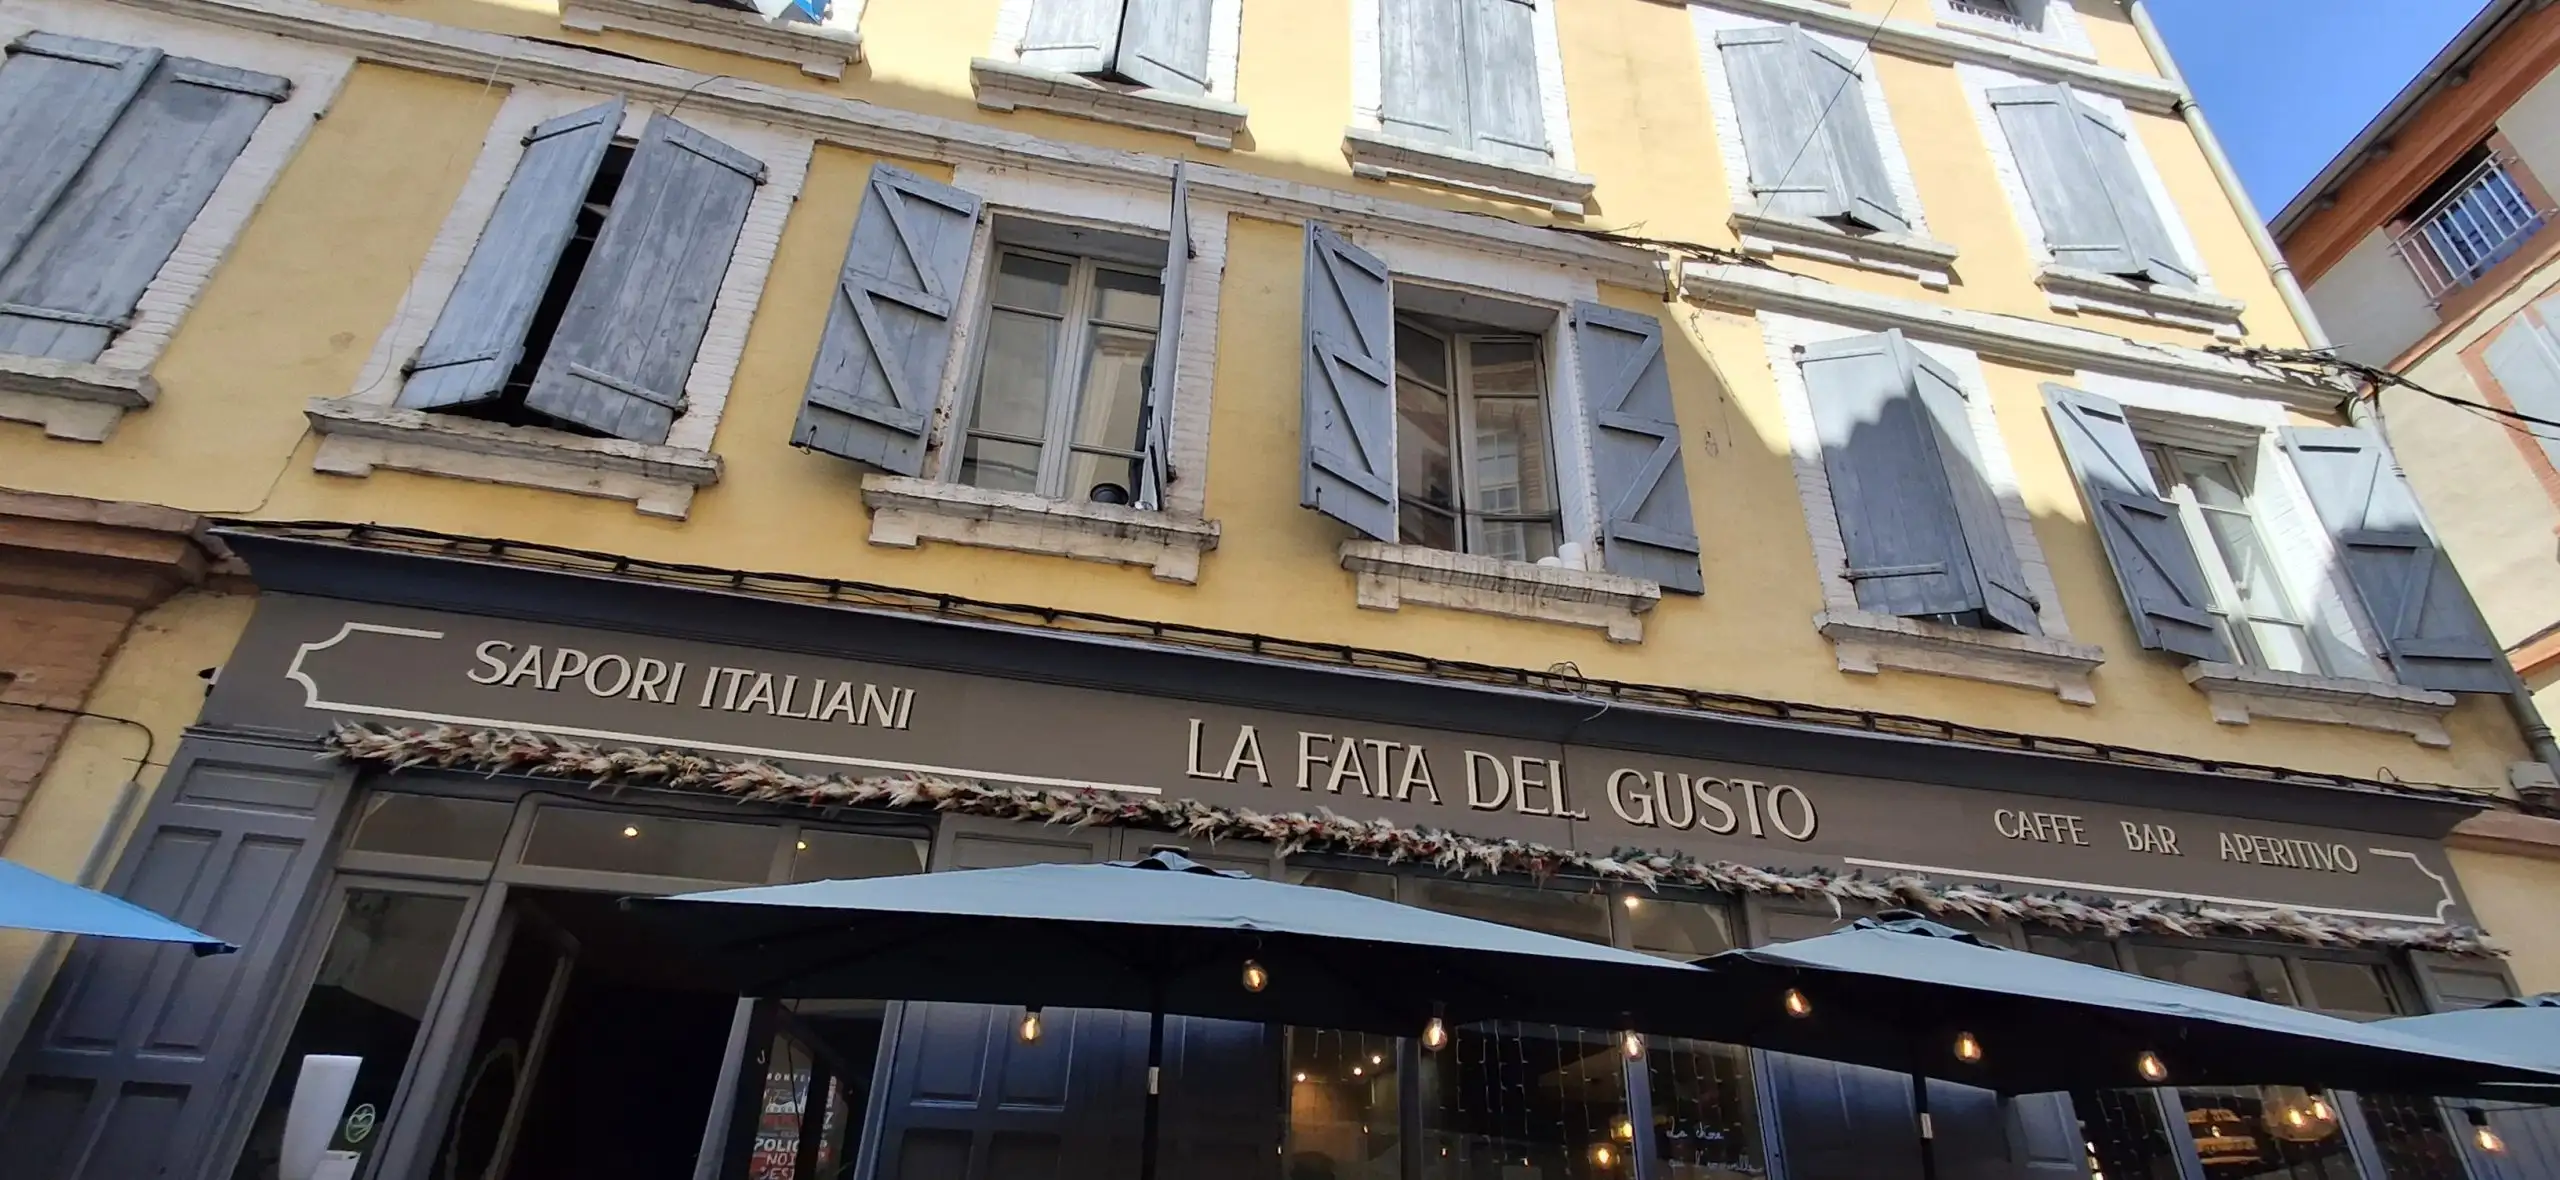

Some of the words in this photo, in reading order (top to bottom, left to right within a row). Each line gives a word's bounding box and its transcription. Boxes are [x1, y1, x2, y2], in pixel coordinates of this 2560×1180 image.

[467, 640, 685, 703] SAPORI
[699, 666, 916, 730] ITALIANI
[1185, 718, 1270, 785] LA
[1295, 731, 1440, 803] FATA
[1464, 750, 1588, 820] DEL
[1606, 768, 1817, 841] GUSTO
[1994, 808, 2090, 846] CAFFE
[2120, 821, 2182, 856] BAR
[2220, 832, 2359, 873] APERITIVO
[754, 1138, 800, 1153] POLIC
[766, 1153, 797, 1166] NOI
